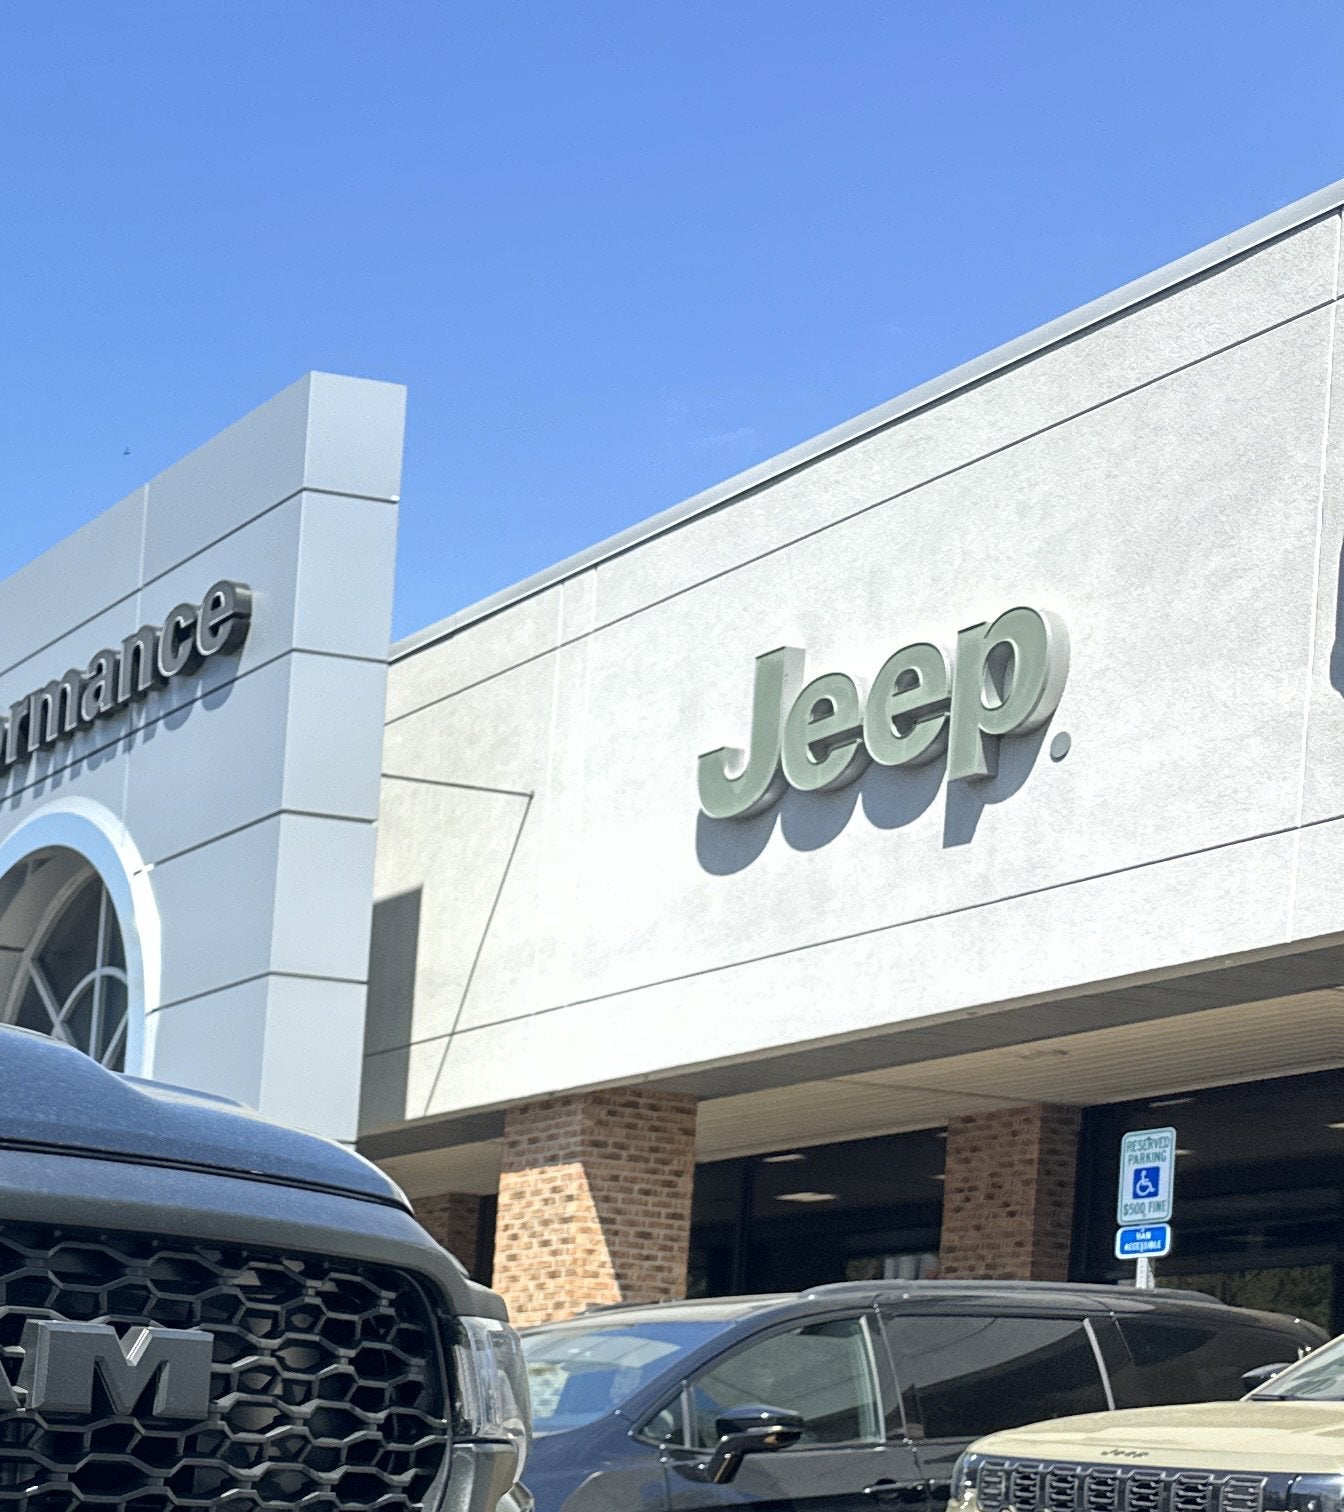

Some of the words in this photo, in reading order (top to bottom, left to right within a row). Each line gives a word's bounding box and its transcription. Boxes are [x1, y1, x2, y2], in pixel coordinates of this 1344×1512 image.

[698, 606, 1070, 819] Jeep
[1127, 1136, 1170, 1152] RESERVED
[1128, 1150, 1167, 1165] PARKING
[1123, 1201, 1146, 1216] $500
[1148, 1200, 1168, 1213] FINE
